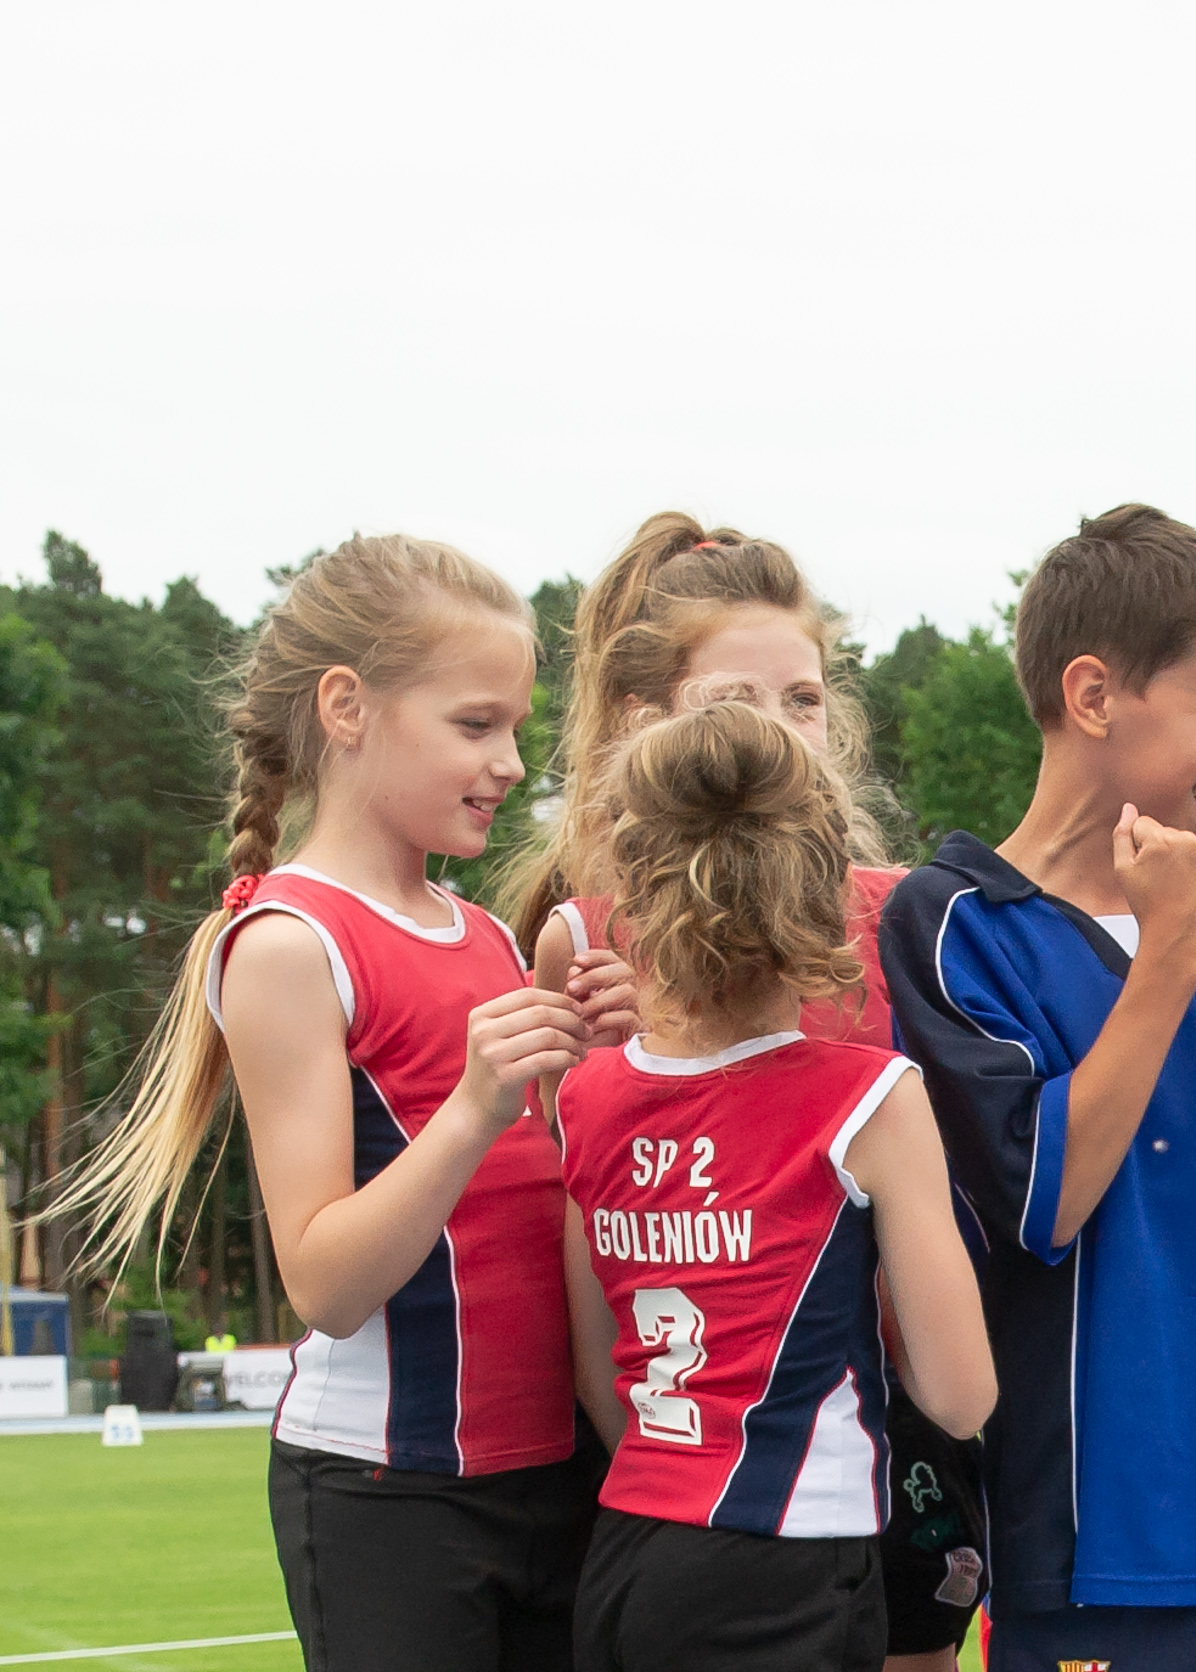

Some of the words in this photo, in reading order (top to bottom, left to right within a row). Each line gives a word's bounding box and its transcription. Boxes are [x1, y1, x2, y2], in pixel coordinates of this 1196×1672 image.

[631, 1136, 678, 1188] SP
[689, 1136, 715, 1188] 2
[593, 1191, 752, 1264] GOLENIÓW
[629, 1286, 709, 1446] 2
